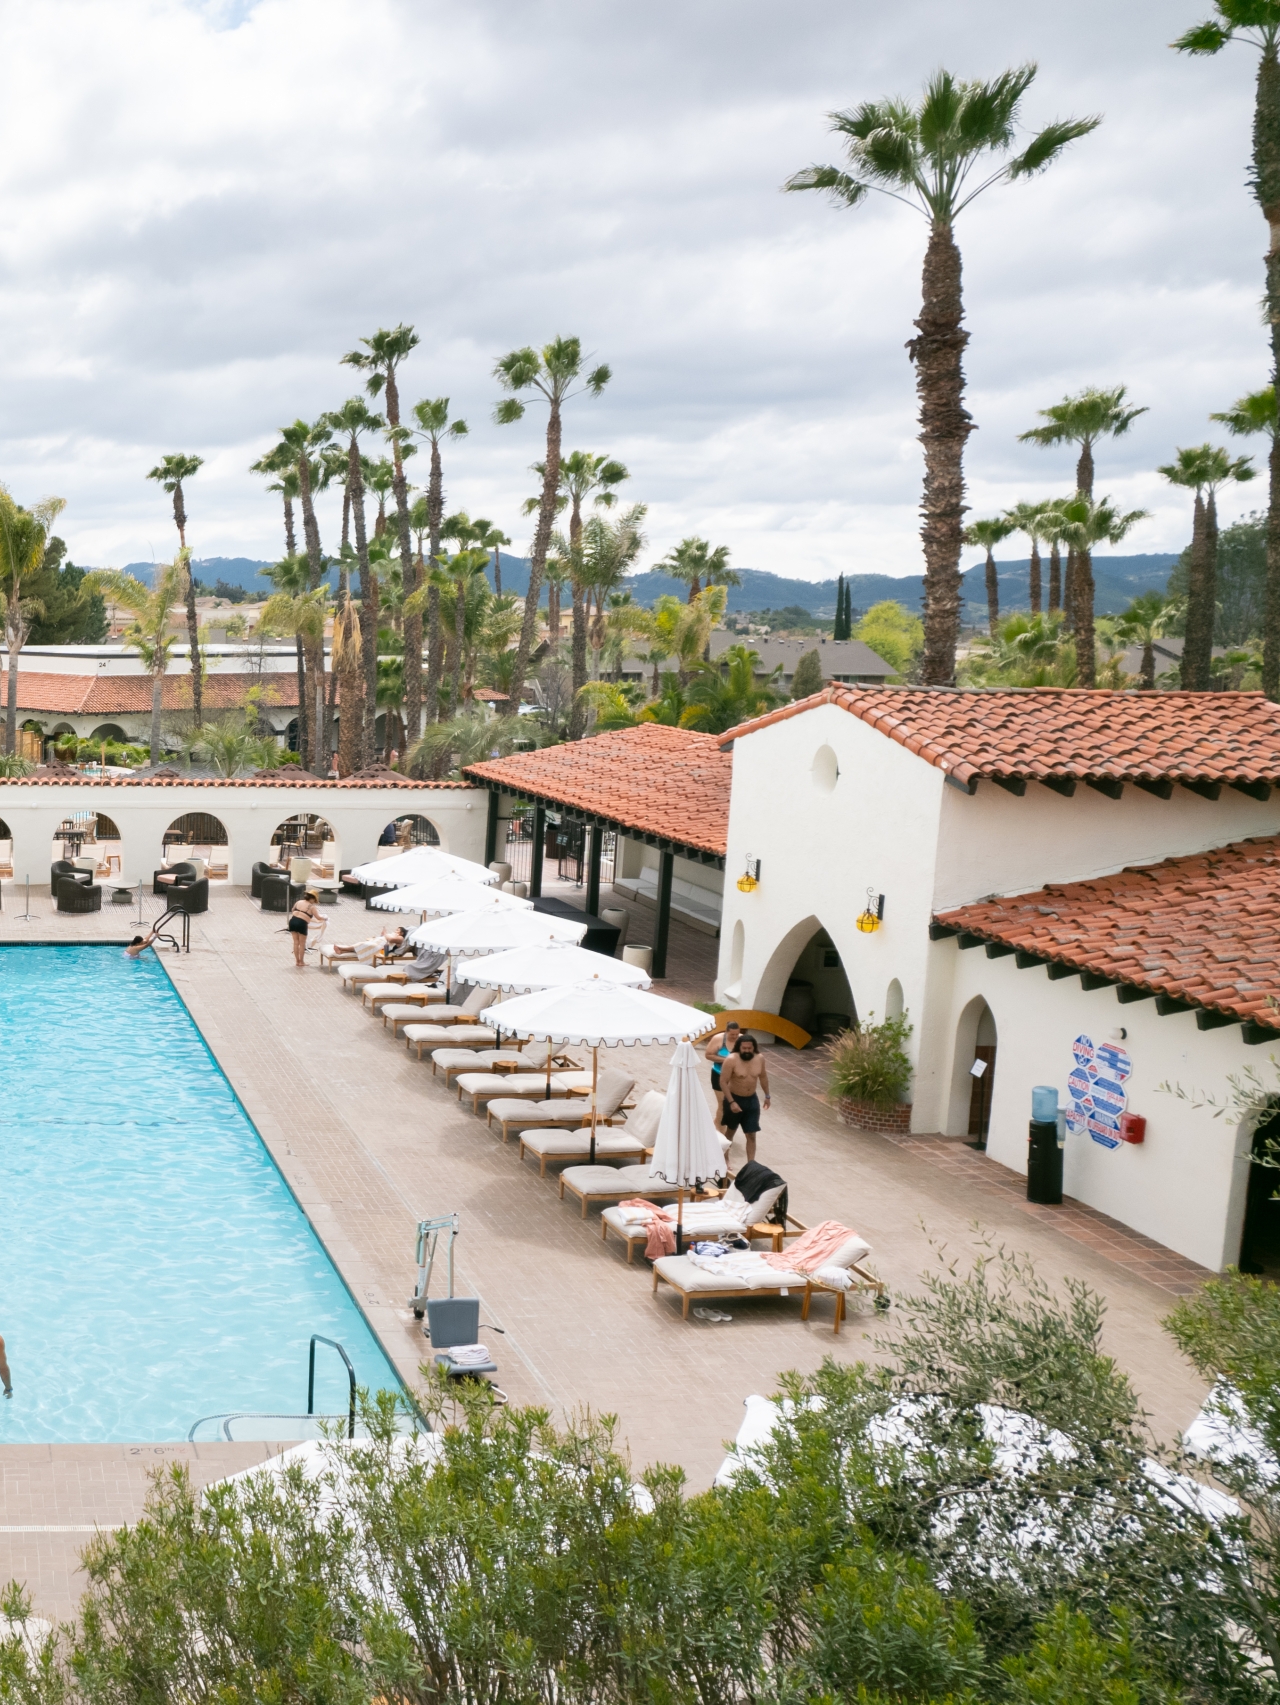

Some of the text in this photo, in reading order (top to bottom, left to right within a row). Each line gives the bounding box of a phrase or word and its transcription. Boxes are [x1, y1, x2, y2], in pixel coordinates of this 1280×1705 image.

[1080, 1034, 1091, 1046] NO
[1073, 1041, 1095, 1059] DIVING
[1068, 1075, 1090, 1093] CAUTION
